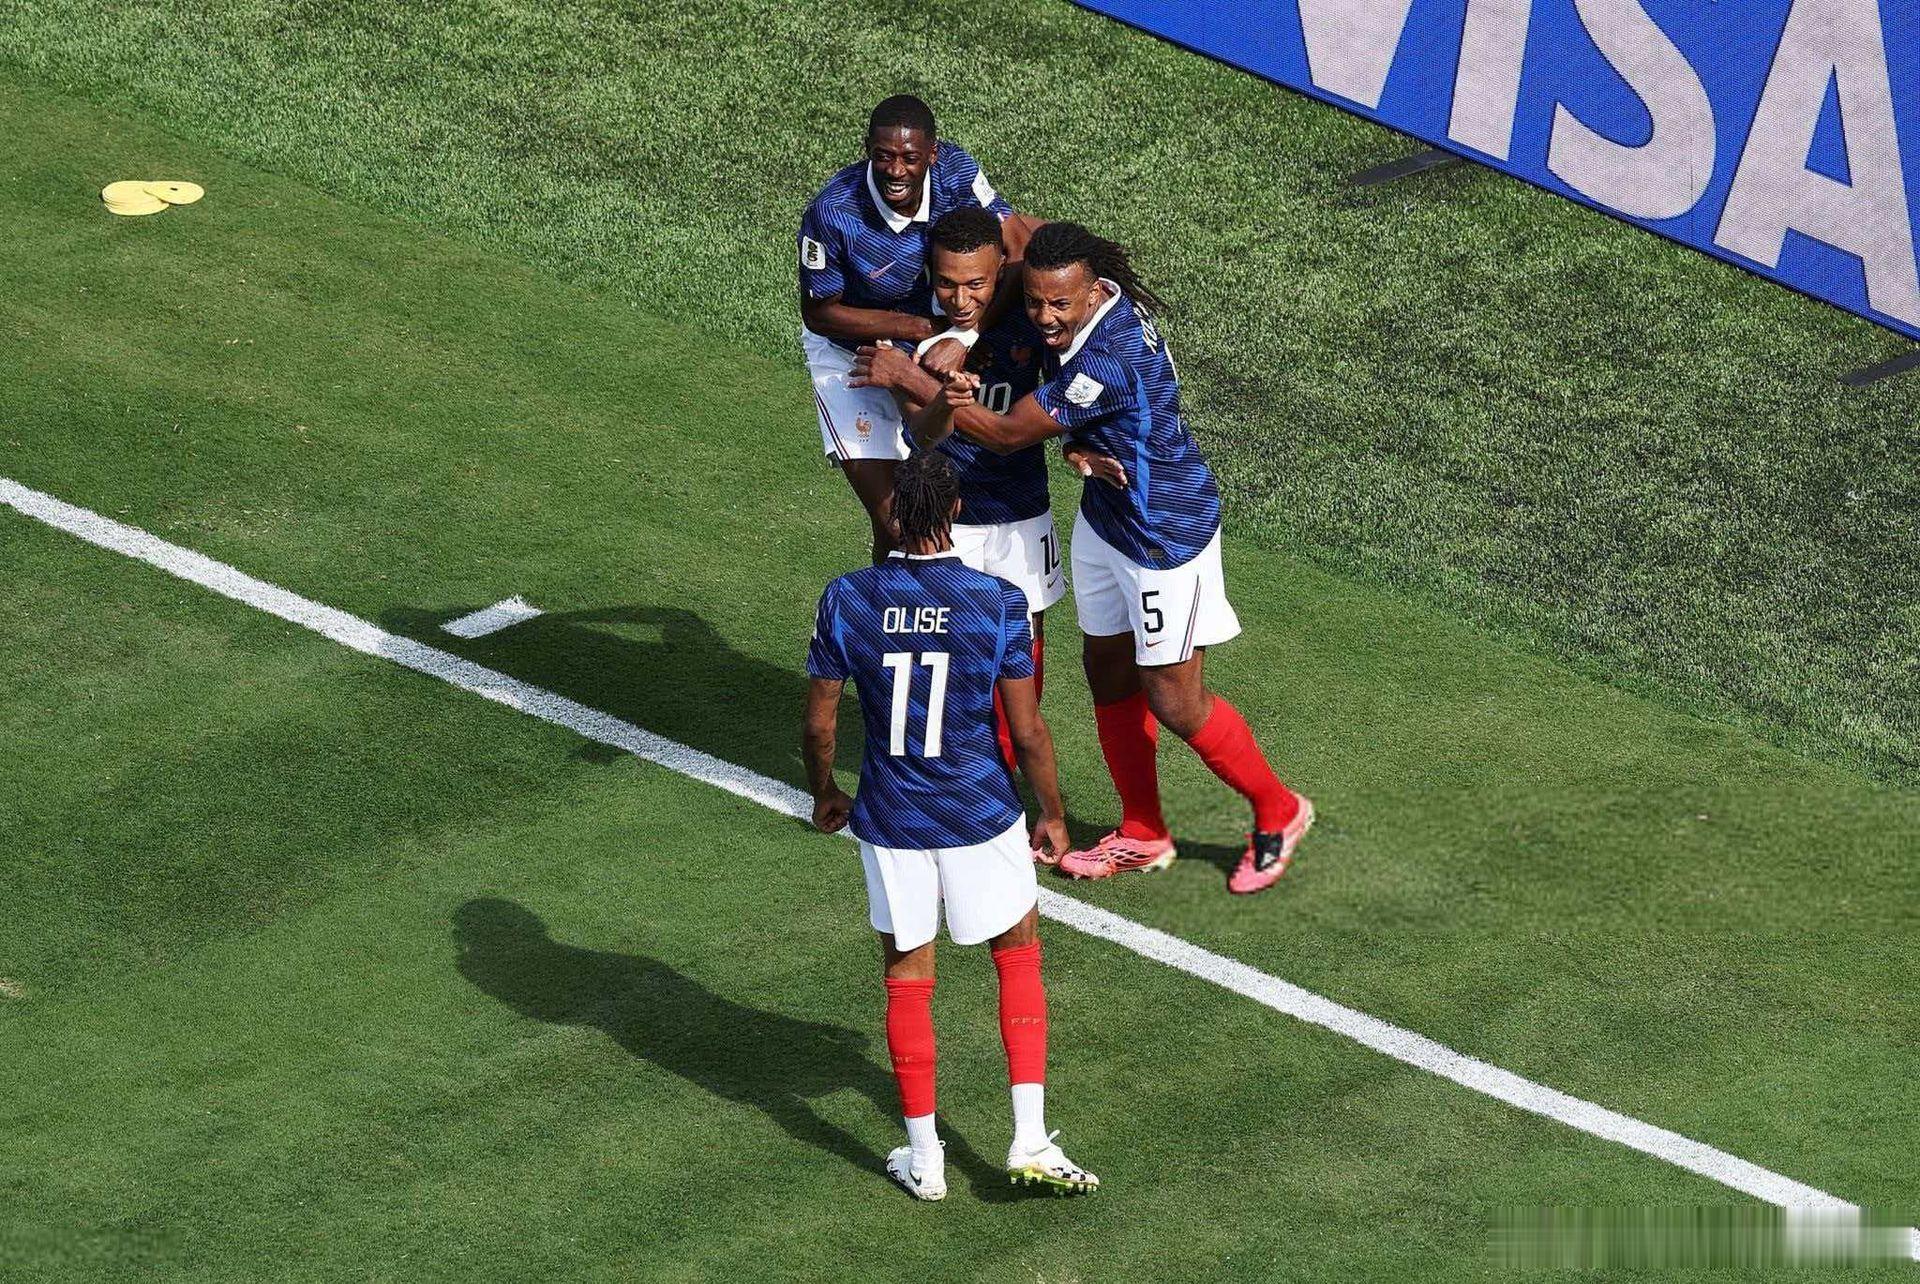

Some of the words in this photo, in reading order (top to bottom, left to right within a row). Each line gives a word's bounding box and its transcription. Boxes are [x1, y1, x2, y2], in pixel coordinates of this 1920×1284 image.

[882, 607, 951, 633] OLISE
[1141, 590, 1164, 634] 5
[882, 651, 950, 758] 11
